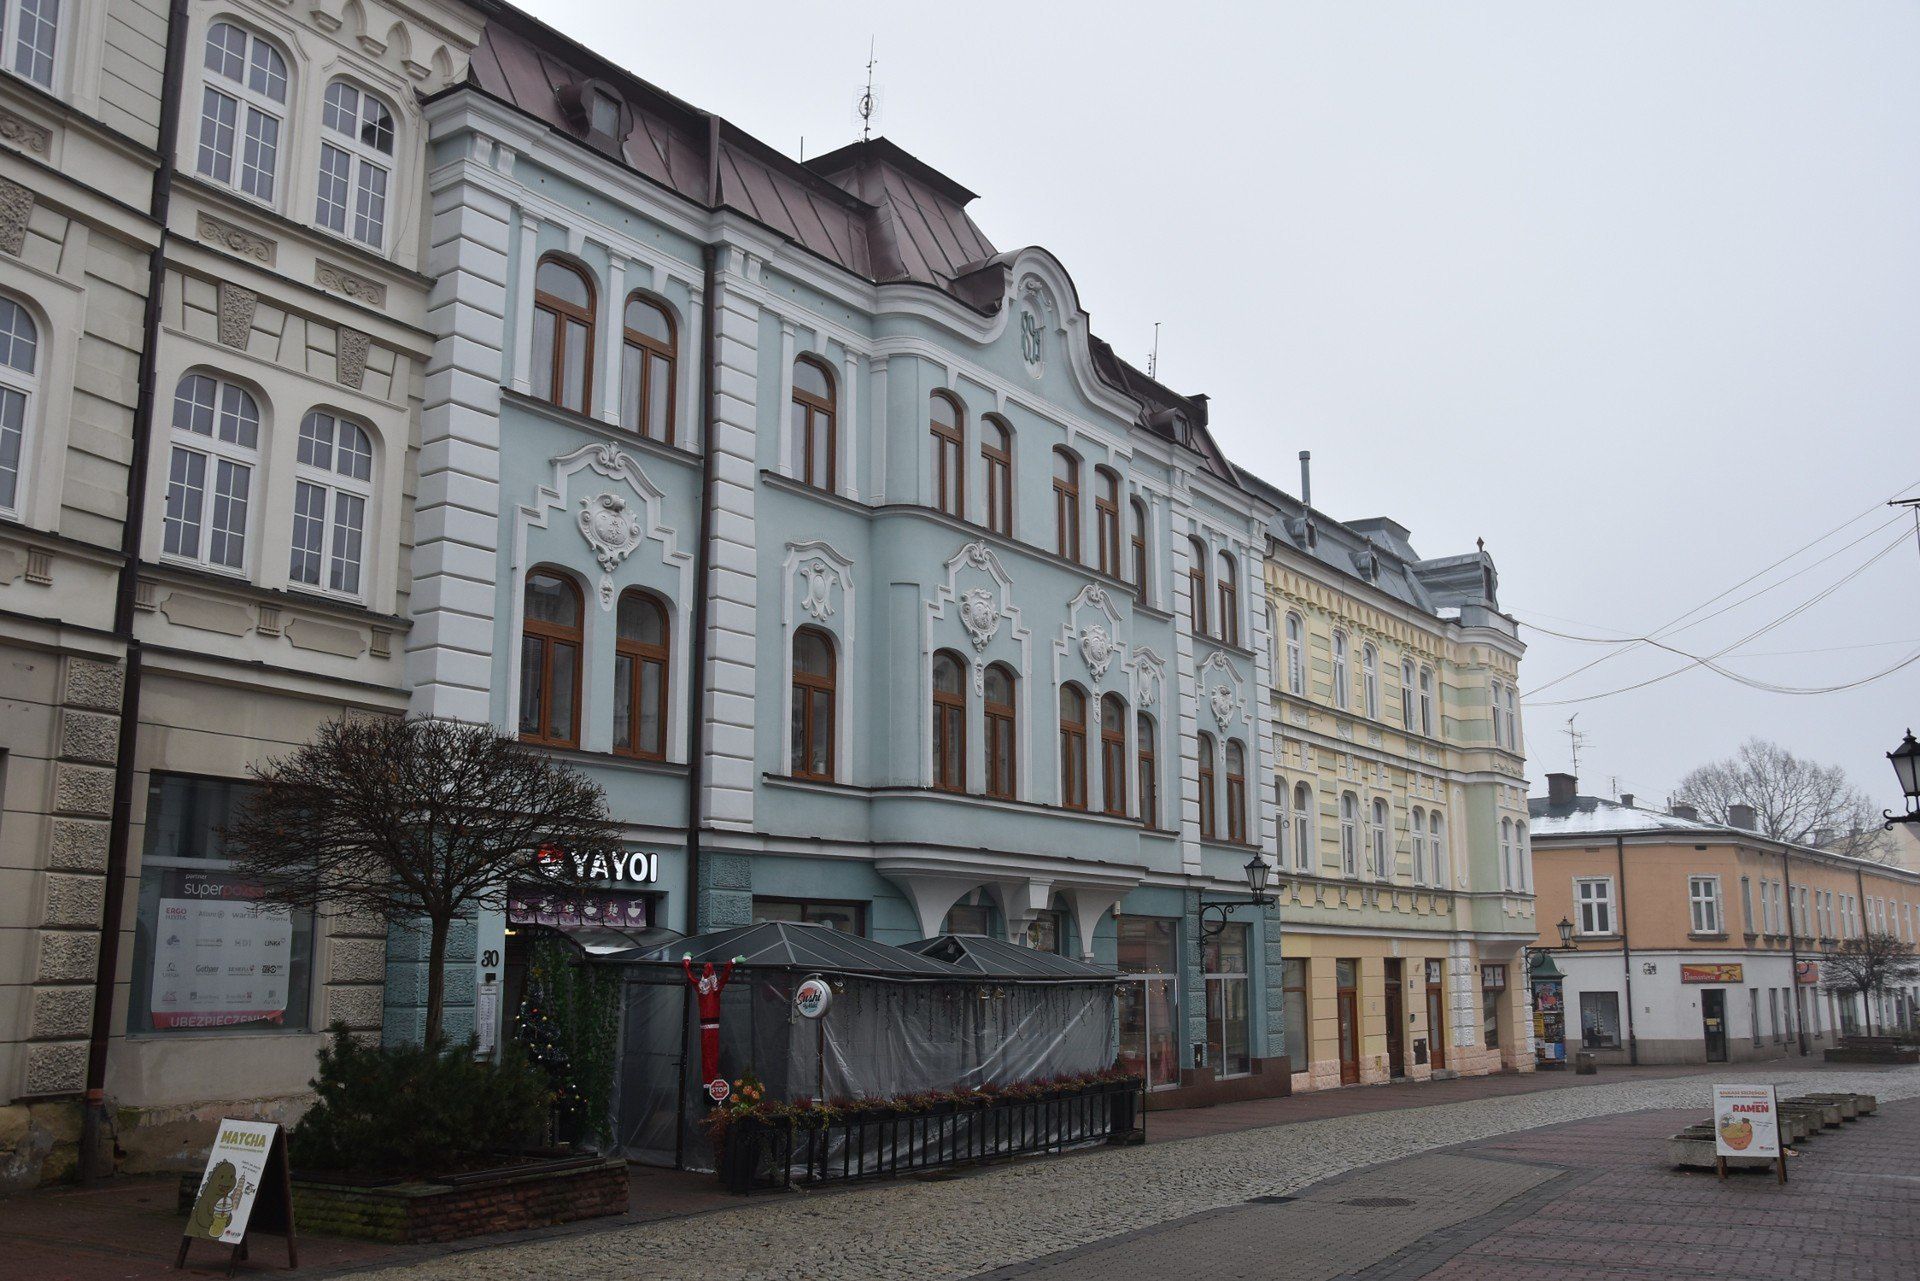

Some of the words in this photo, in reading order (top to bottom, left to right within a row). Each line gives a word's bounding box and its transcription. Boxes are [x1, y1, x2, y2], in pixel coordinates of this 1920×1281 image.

[571, 850, 658, 883] YAYOI
[481, 950, 499, 968] 30
[797, 991, 822, 1005] Sushi
[1733, 1104, 1769, 1112] RAMEN
[220, 1131, 267, 1147] MATCHA
